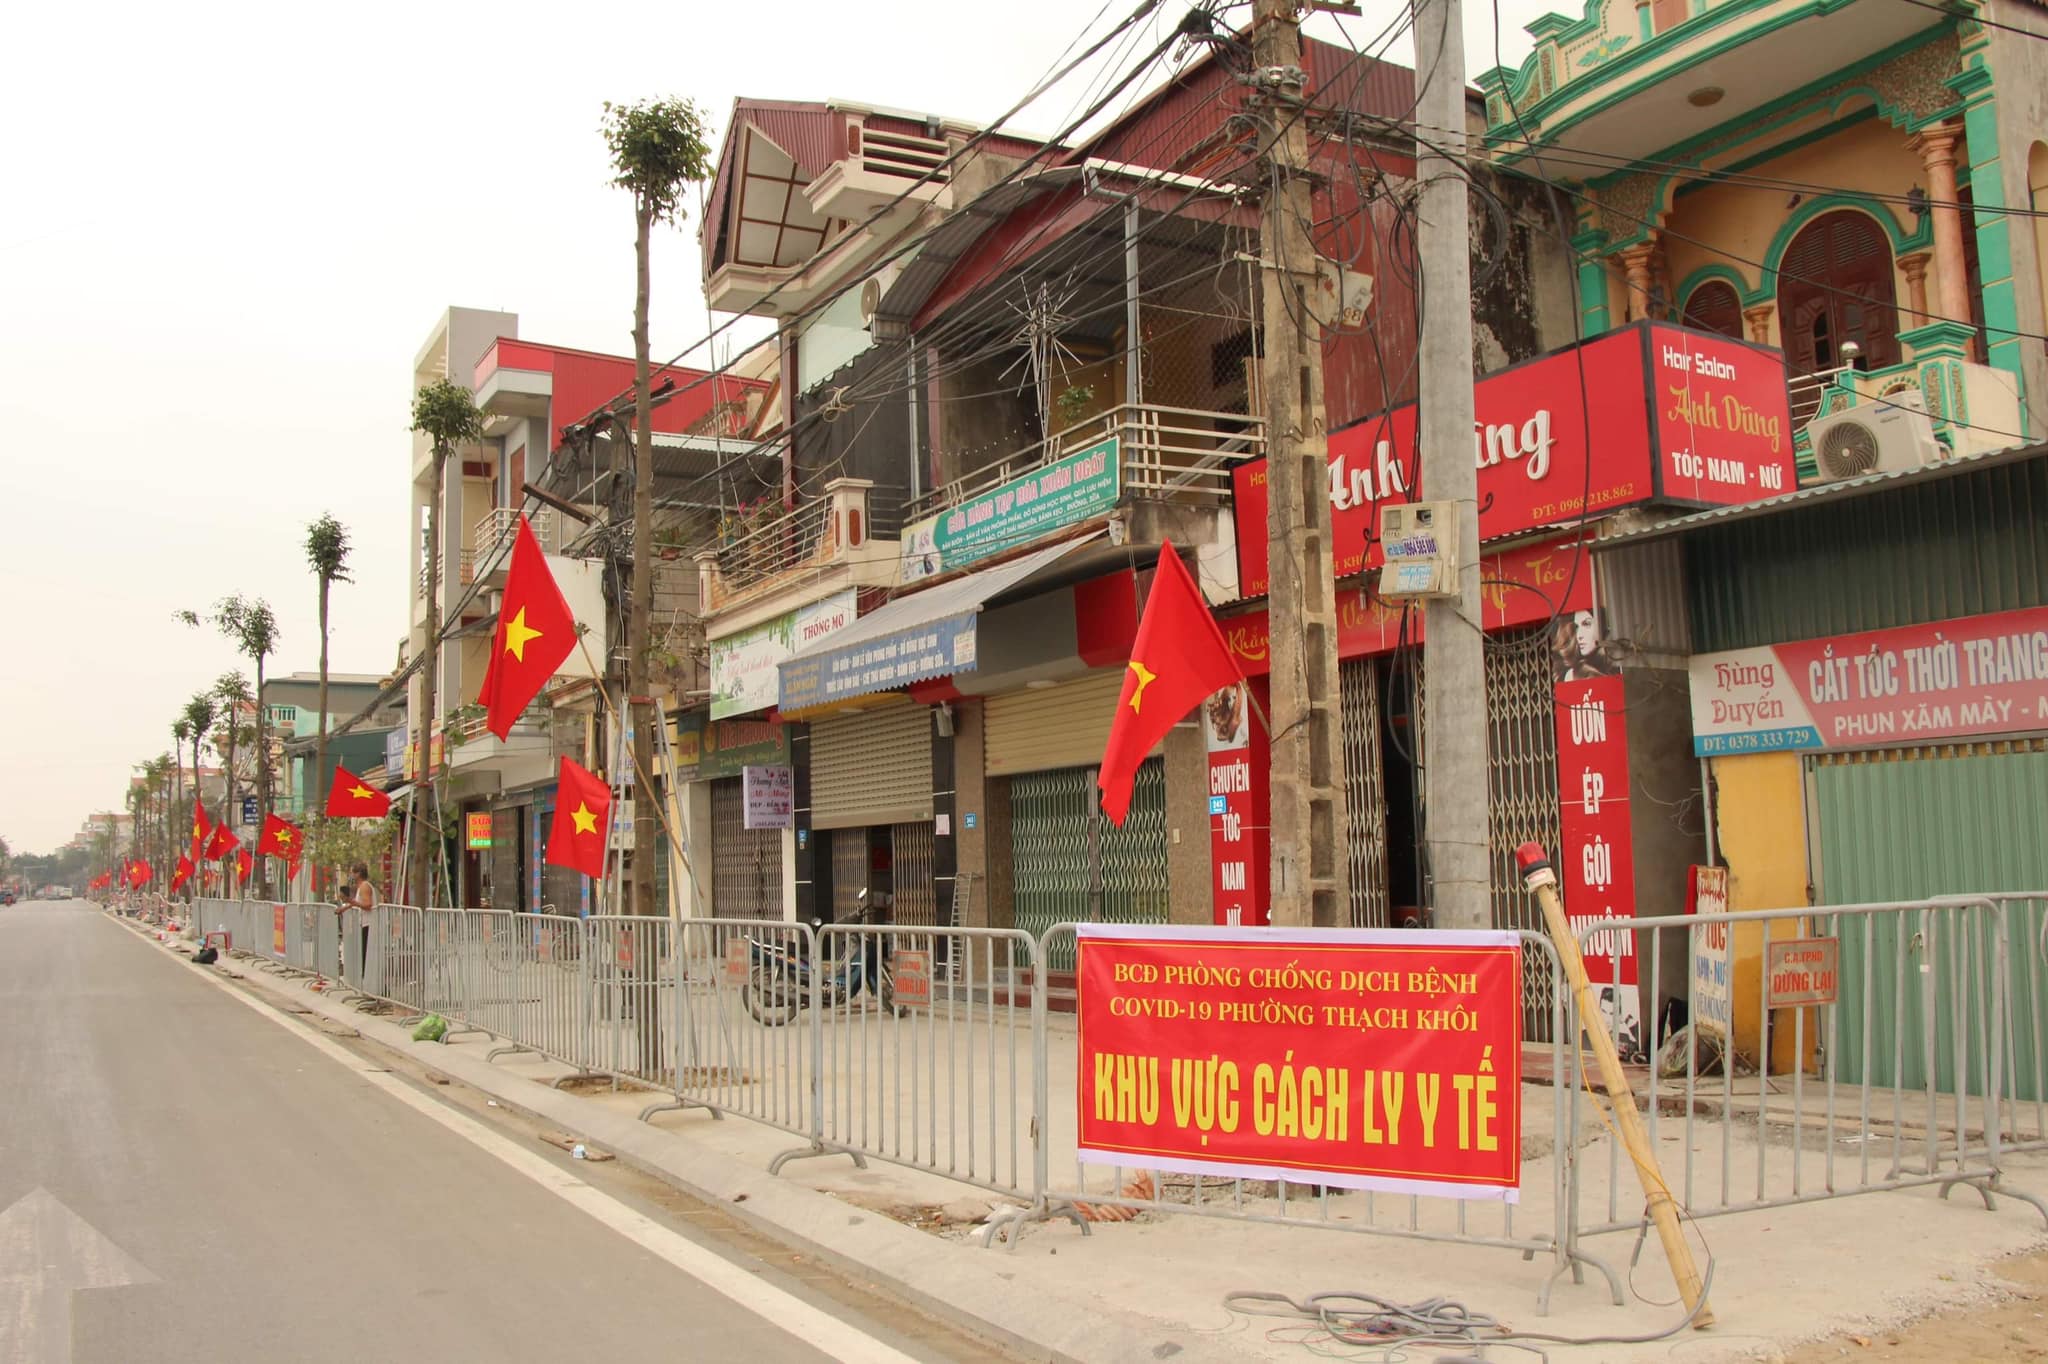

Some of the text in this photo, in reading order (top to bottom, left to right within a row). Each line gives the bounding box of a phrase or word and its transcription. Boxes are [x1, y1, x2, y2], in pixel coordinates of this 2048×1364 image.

[1664, 345, 1736, 381] Hair Salon
[1668, 385, 1781, 453] Anh Dũng
[1672, 448, 1704, 480] TÓC
[1707, 457, 1746, 486] NAM
[1759, 463, 1783, 490] NỮ
[1526, 555, 1568, 587] Tóc
[1714, 661, 1775, 692] Hùng
[1808, 631, 2048, 705] CẮT TÓC THỜI TRANG
[1570, 689, 1607, 745] UỐN
[1834, 711, 1896, 738] PHUN
[1901, 703, 1953, 732] XĂM
[1959, 695, 2013, 726] MÀY
[1703, 730, 1811, 752] ĐT: 0378 333 729
[1210, 757, 1250, 795] CHUYÊN
[1582, 766, 1604, 815] ÉP
[1221, 806, 1241, 843] TÓC
[1221, 861, 1246, 891] NAM
[1582, 834, 1612, 892] GỘI
[1114, 960, 1478, 998] BCĐ PHÒNG CHỐNG DỊCH BỆNH
[1110, 997, 1478, 1033] COVID-19 PHƯỜNG THẠCH KHÔI
[1095, 1045, 1498, 1152] KHU VỰC CÁCH LY Y TẾ
